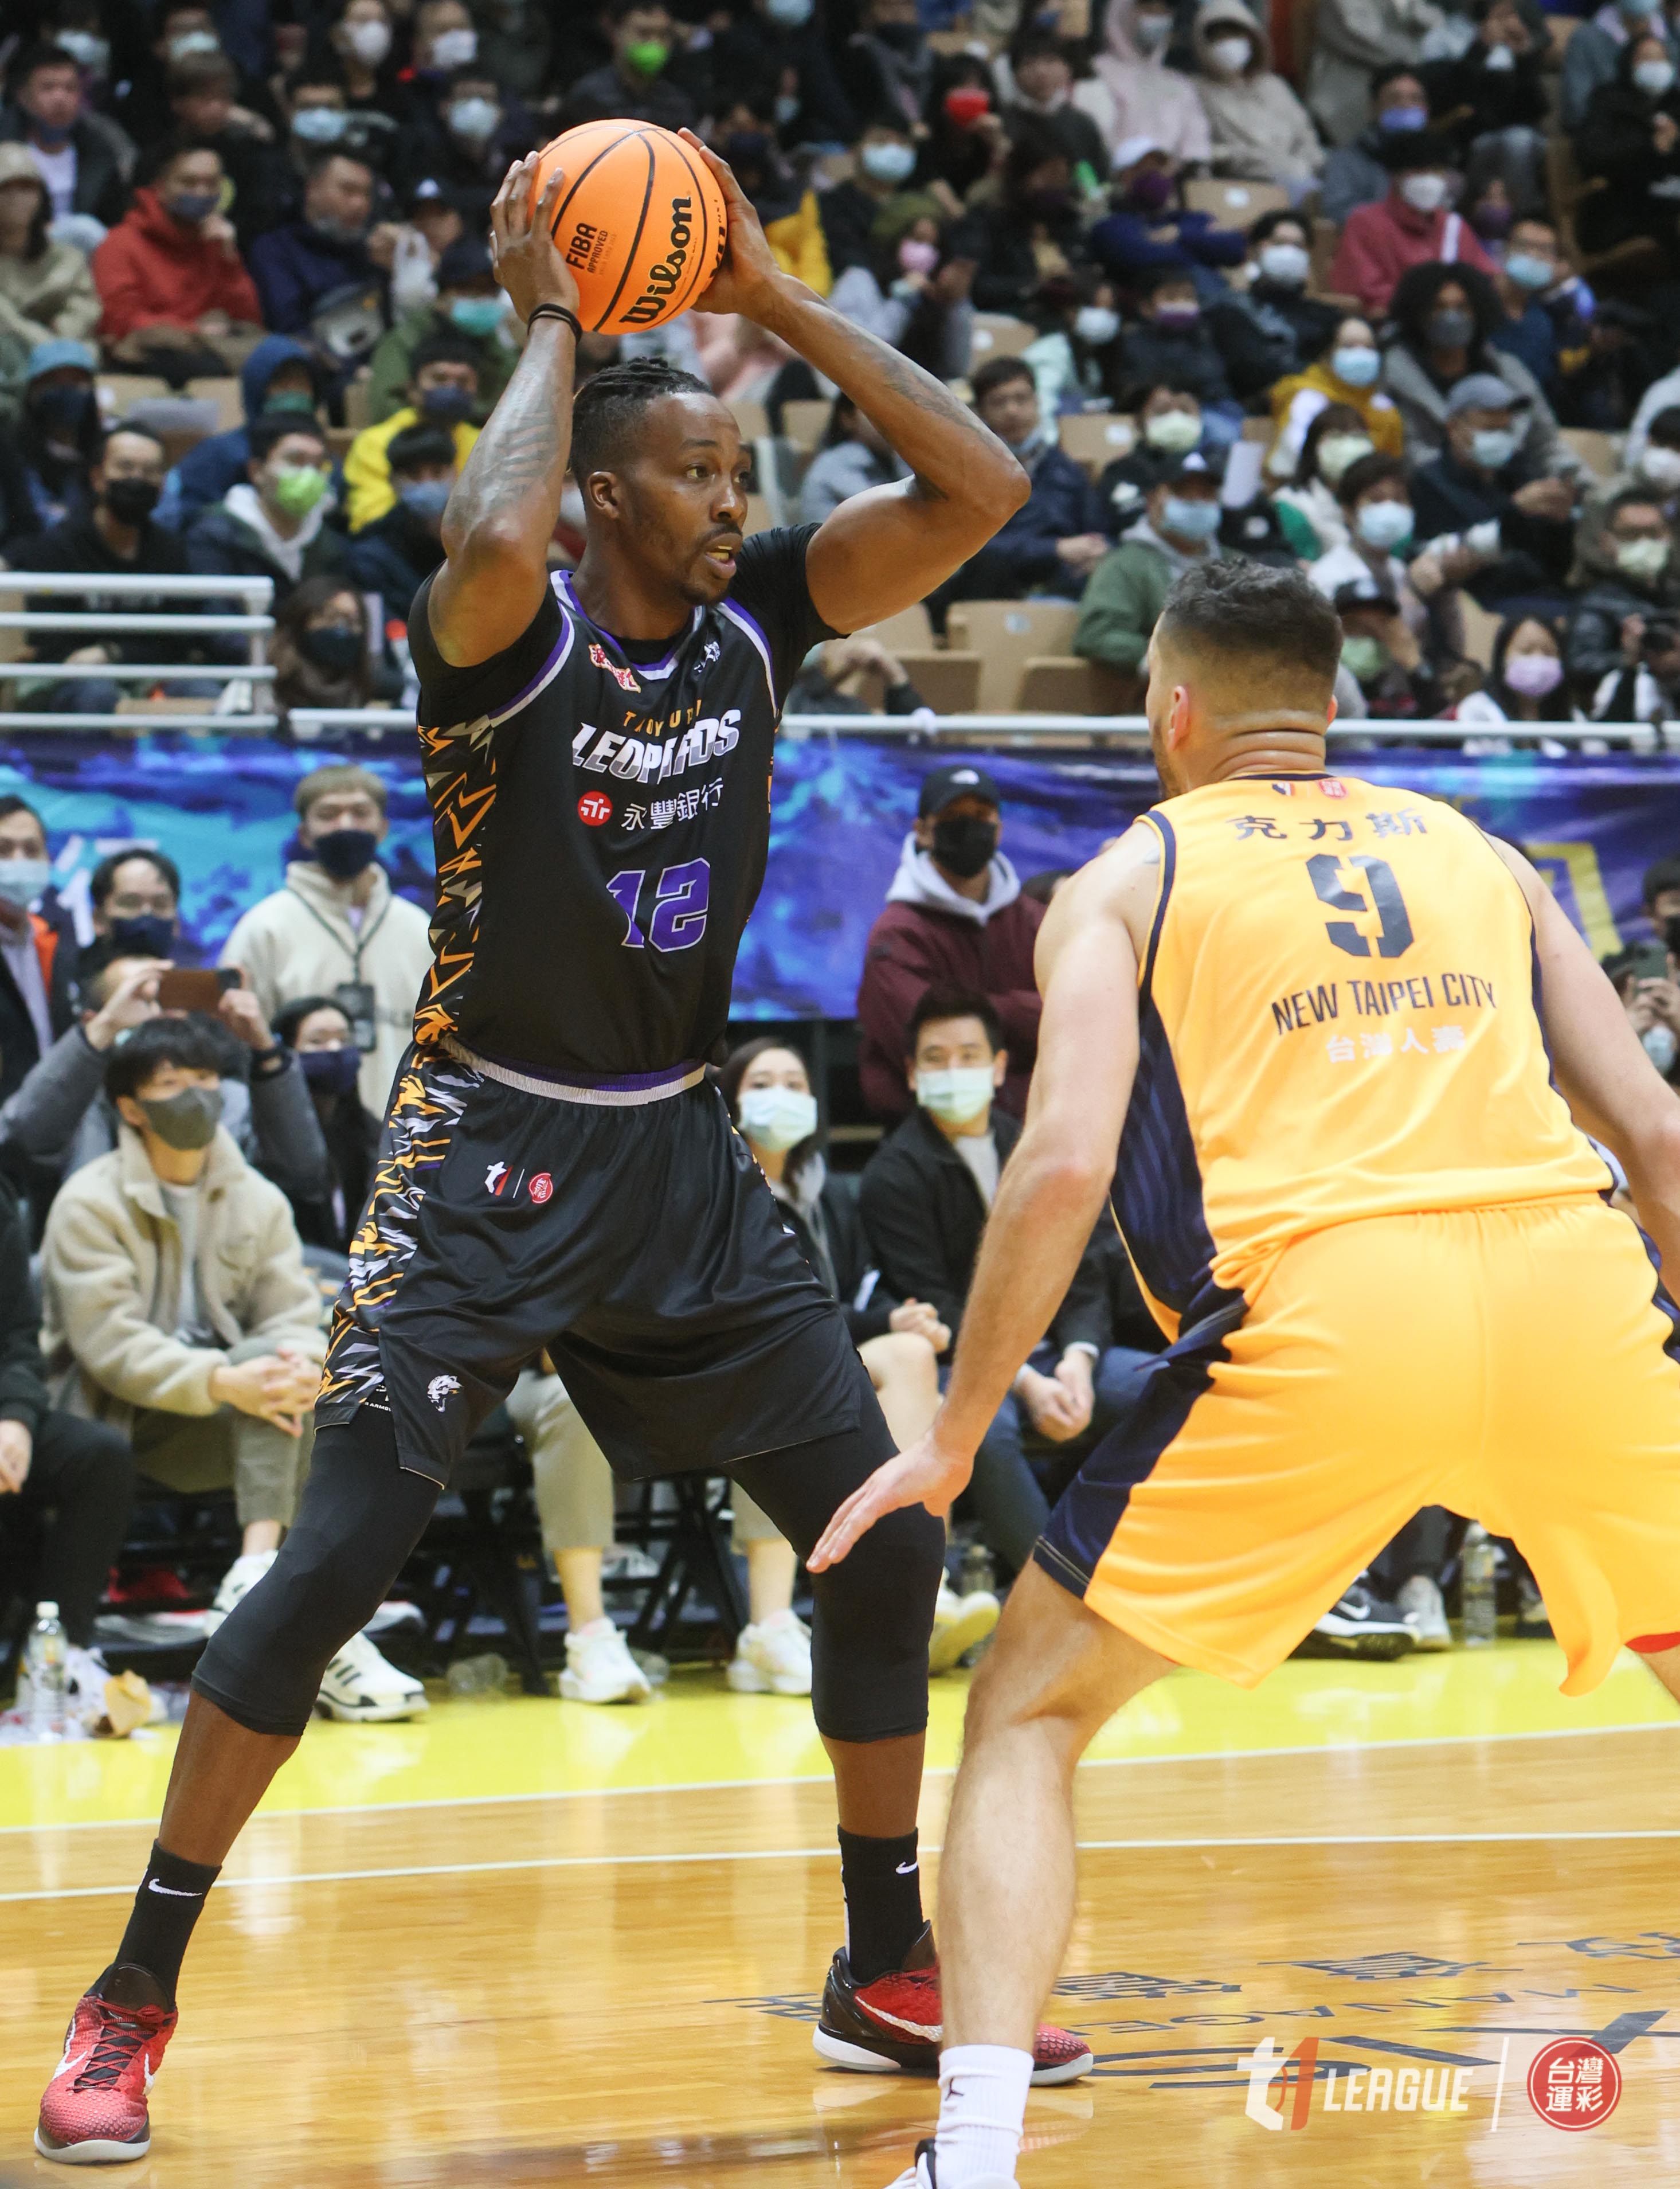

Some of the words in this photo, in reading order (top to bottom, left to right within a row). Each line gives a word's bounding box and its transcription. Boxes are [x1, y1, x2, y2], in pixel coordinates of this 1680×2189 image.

[566, 222, 597, 270] FIBA
[587, 230, 608, 273] APPROVED
[619, 196, 692, 324] Wilson
[621, 777, 723, 831] 永豐銀行
[1225, 808, 1428, 841] 克力斯
[606, 857, 711, 953] 12
[1305, 854, 1415, 958] 9
[1271, 983, 1338, 1035] NEW
[1347, 976, 1434, 1015] TAIPEI
[1441, 973, 1497, 1008] CITY
[1325, 1025, 1467, 1063] 台灣人壽
[369, 1402, 392, 1412] ARMO
[1063, 1984, 1643, 2036] MANAGE
